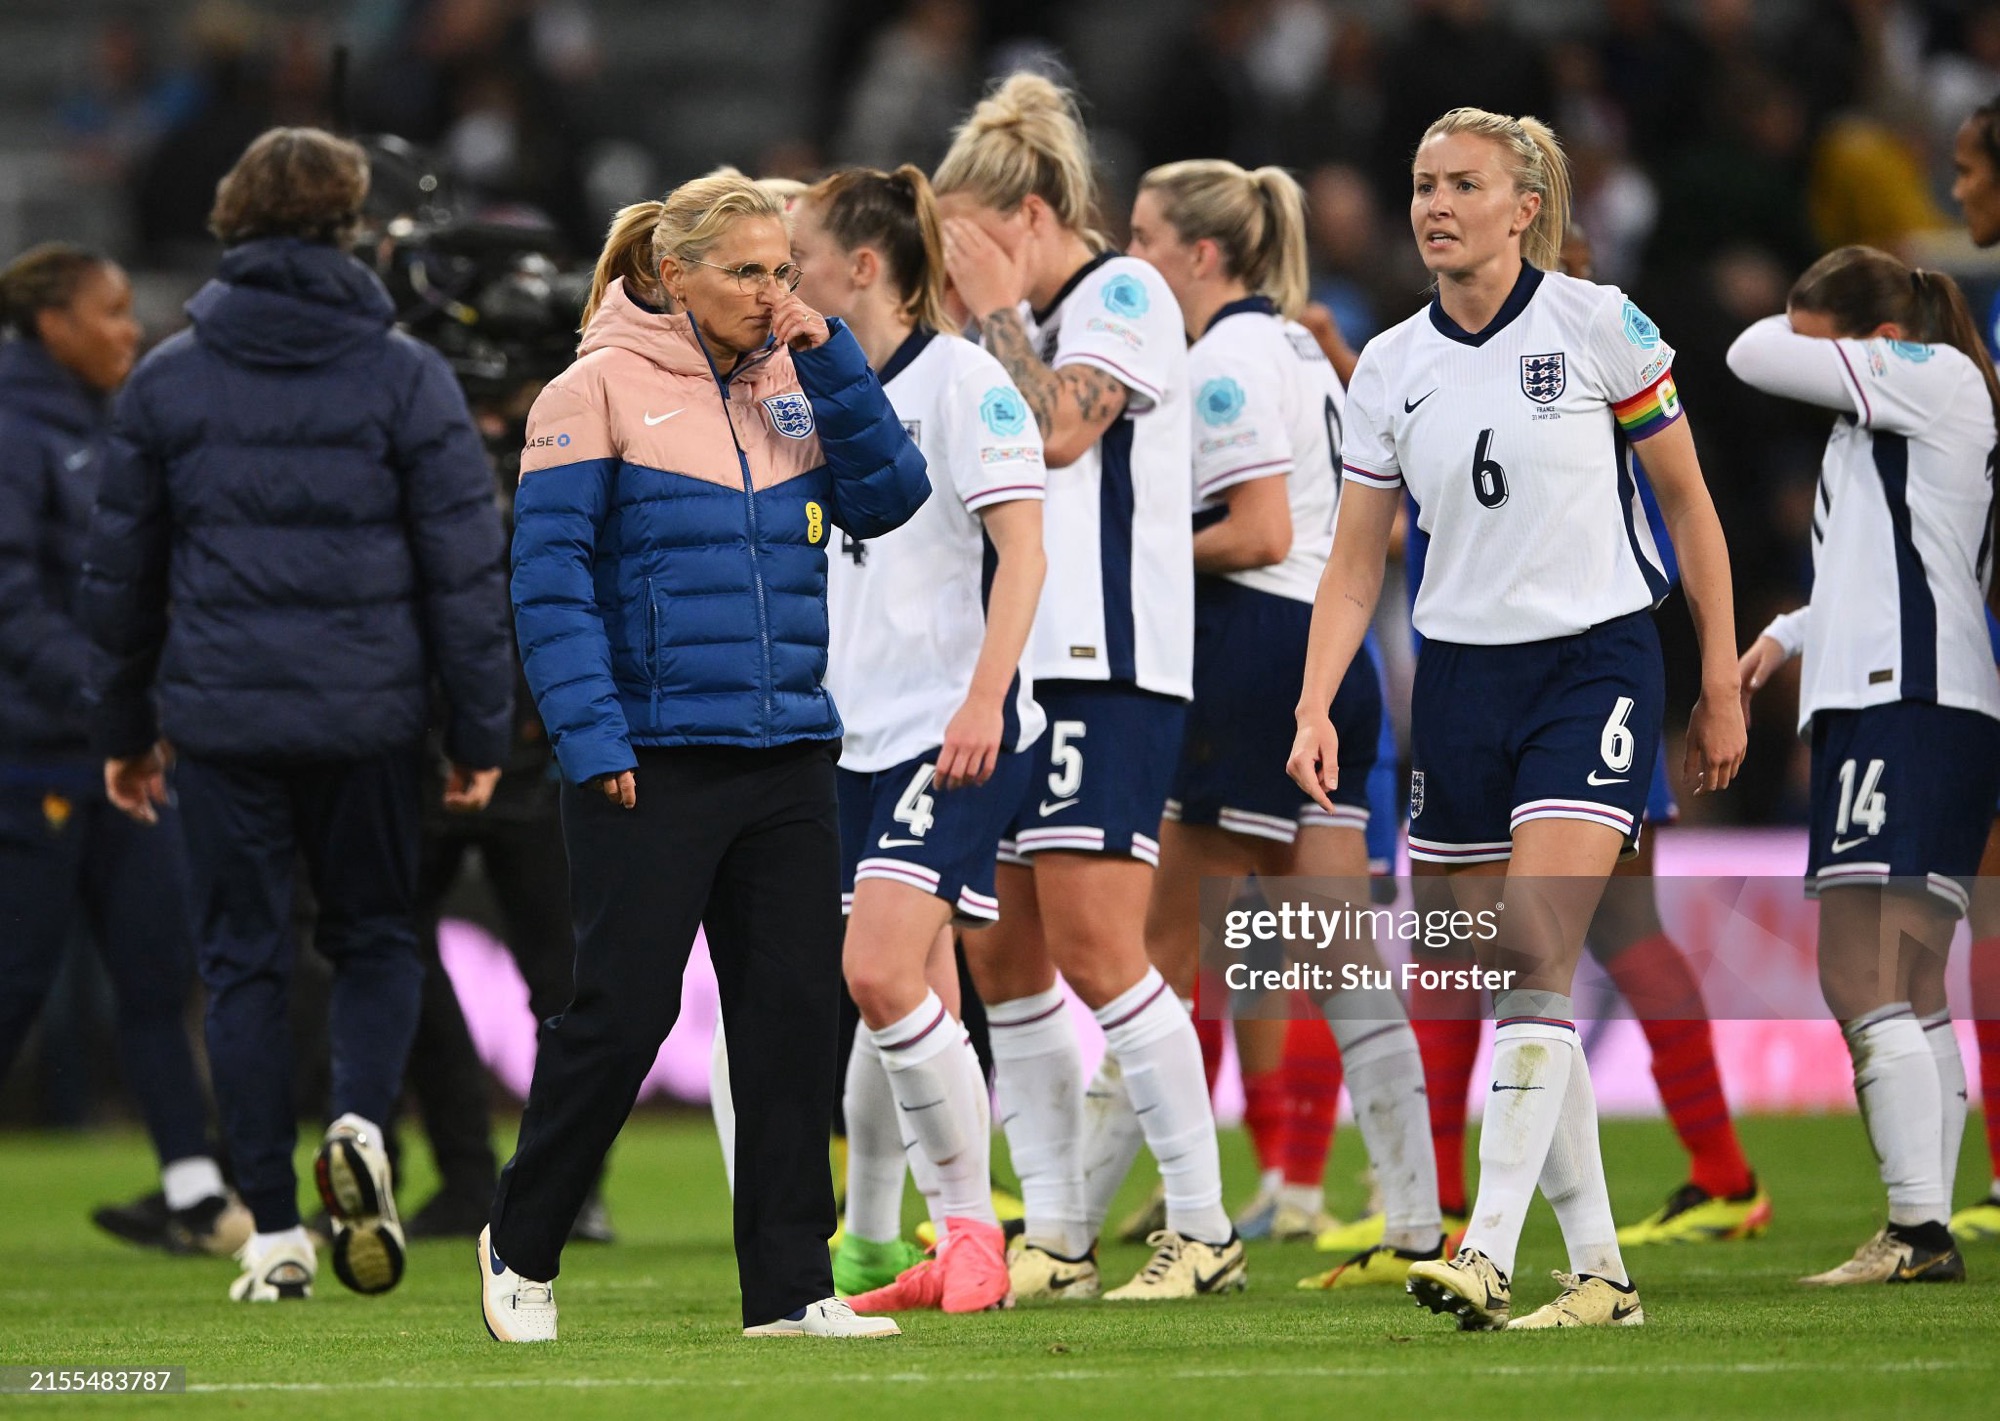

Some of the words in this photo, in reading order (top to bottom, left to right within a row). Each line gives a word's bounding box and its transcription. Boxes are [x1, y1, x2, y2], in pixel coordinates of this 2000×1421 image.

[1656, 379, 1680, 419] C
[1472, 428, 1509, 509] 6
[1048, 720, 1086, 798] 5
[1601, 696, 1634, 773] 6
[893, 762, 937, 837] 4
[1836, 758, 1886, 836] 14
